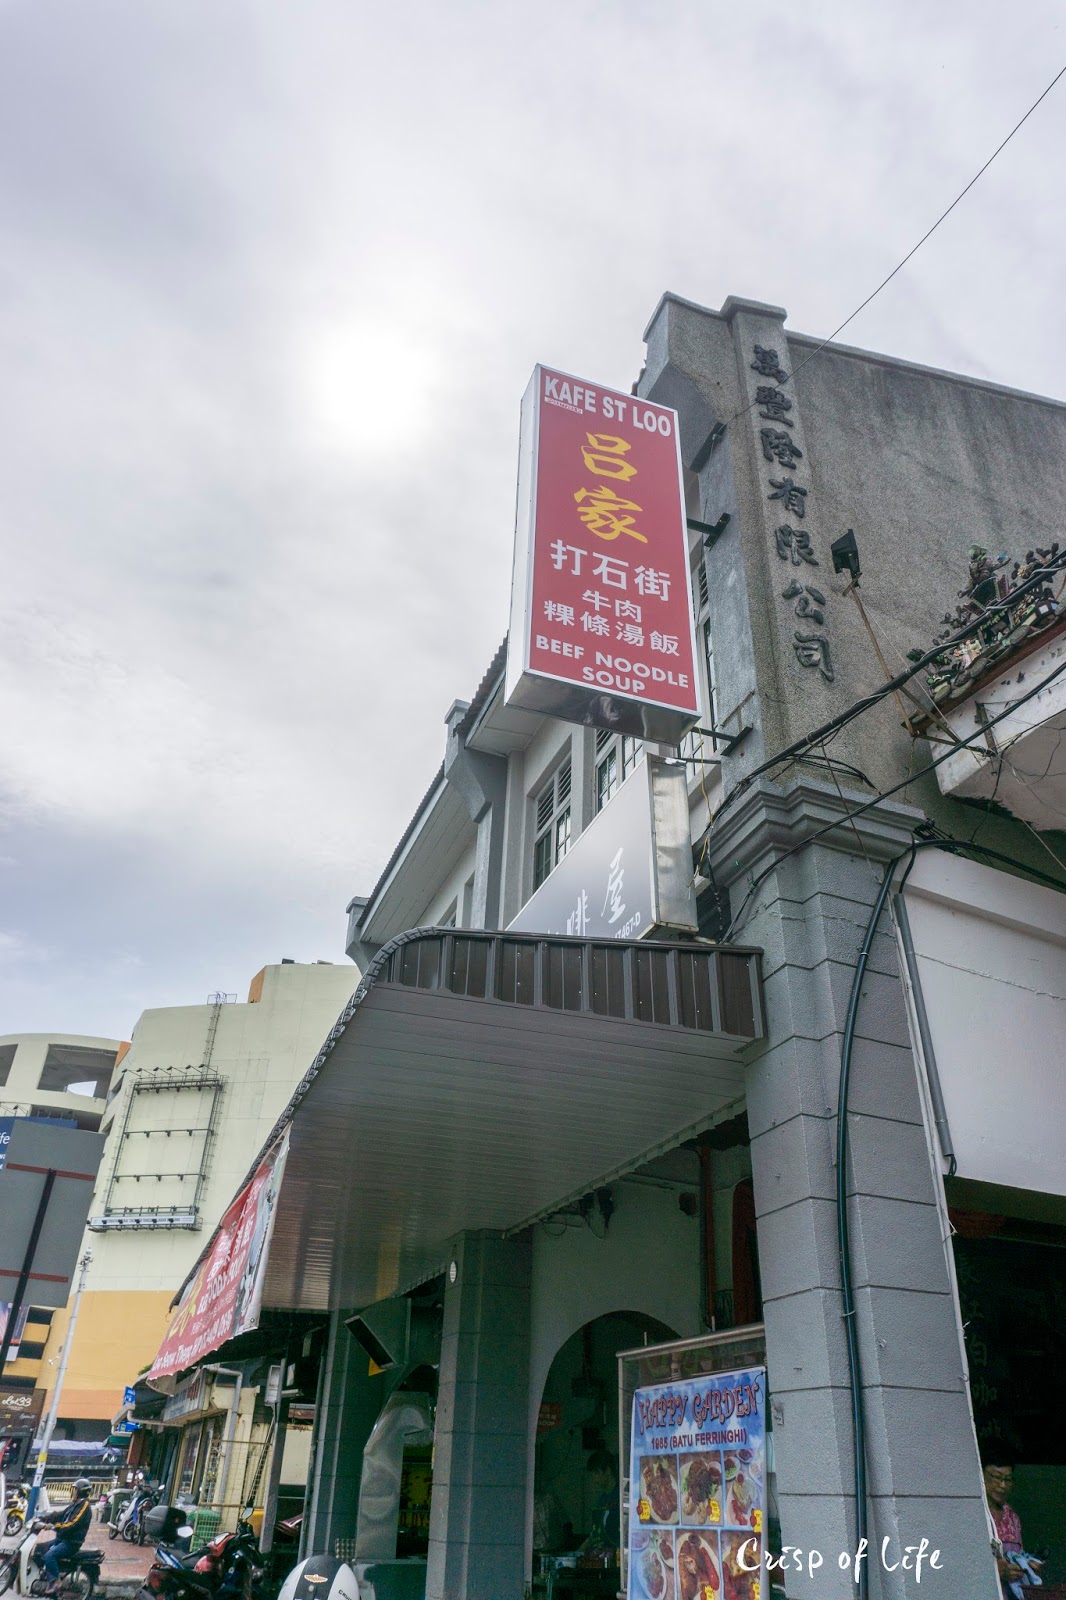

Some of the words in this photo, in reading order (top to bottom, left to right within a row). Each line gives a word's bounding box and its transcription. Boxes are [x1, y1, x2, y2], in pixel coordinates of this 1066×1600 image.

[545, 375, 597, 413] KAFE
[602, 396, 627, 422] ST
[633, 406, 671, 437] LOO
[550, 540, 672, 602] 打石街
[543, 600, 680, 657] 粿條湯飯
[582, 589, 642, 623] 牛肉
[536, 634, 584, 660] BEEF
[595, 651, 689, 689] NOODLE
[582, 666, 646, 694] SOUP
[639, 1393, 688, 1435] HAPPY
[691, 1382, 760, 1429] GARDEN
[670, 1434, 693, 1450] (BATU
[695, 1428, 748, 1445] FERRINGHI)
